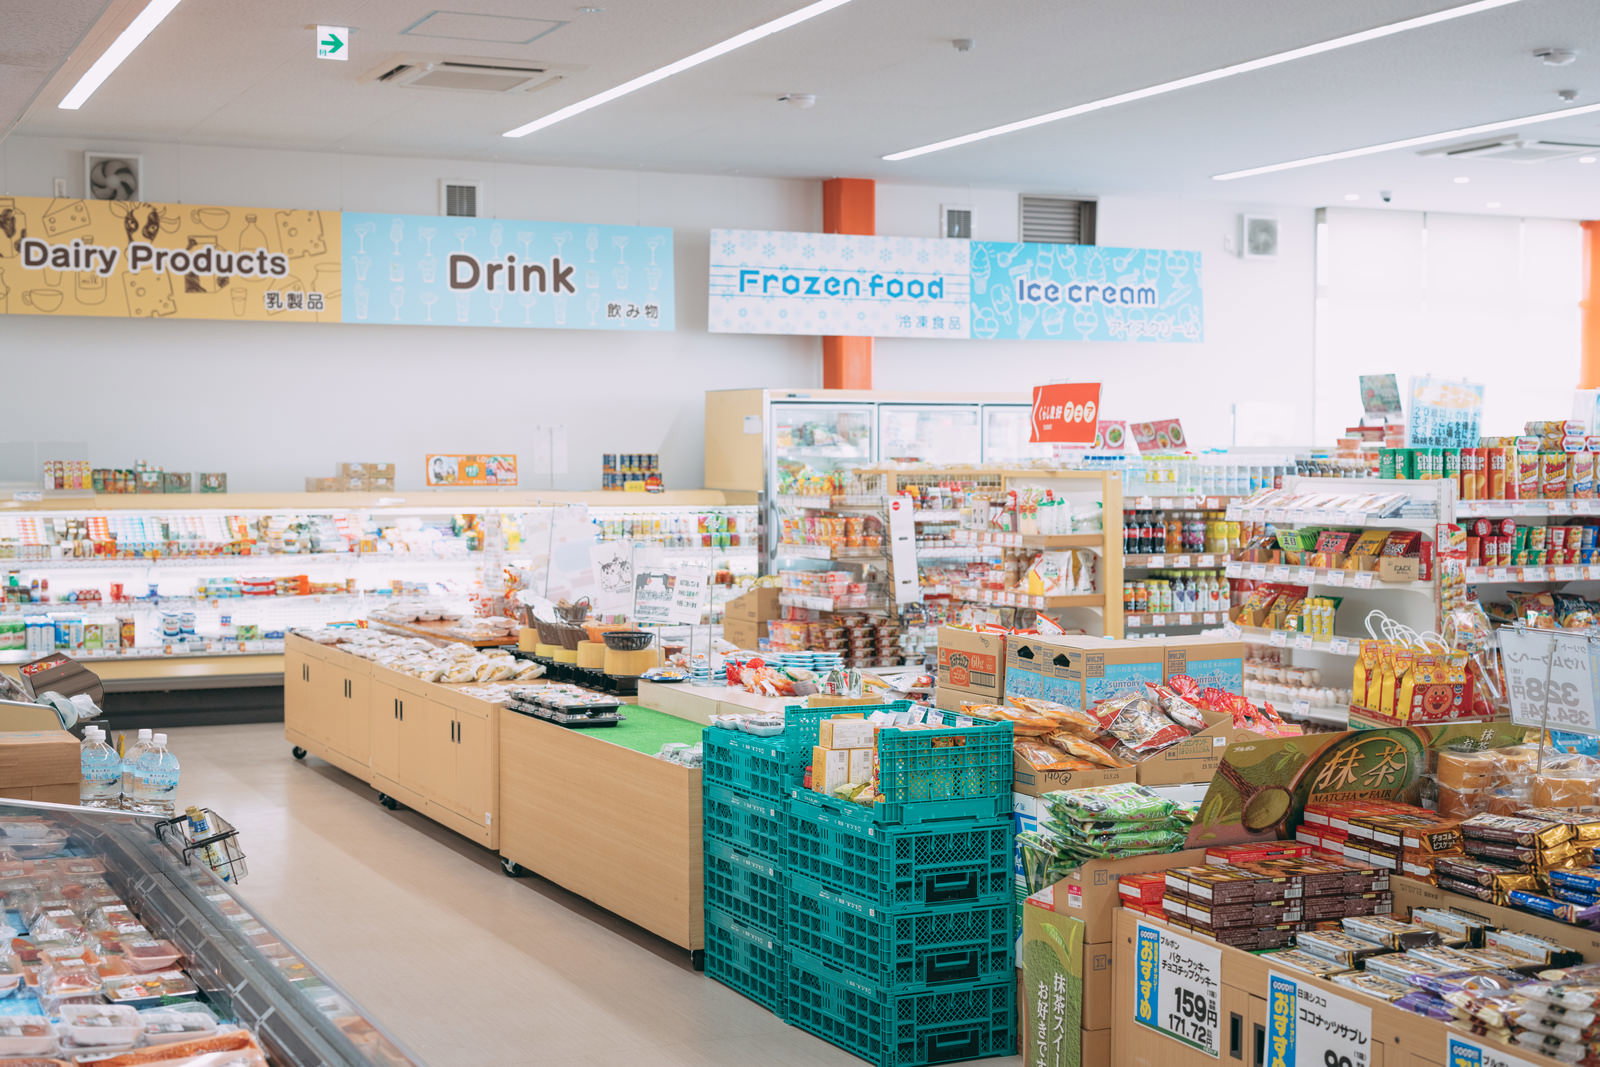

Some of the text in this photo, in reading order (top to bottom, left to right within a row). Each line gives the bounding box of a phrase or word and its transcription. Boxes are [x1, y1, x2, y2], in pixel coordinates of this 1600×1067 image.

[24, 241, 287, 275] Dairy Products
[450, 254, 575, 293] Drink
[739, 269, 944, 300] Frozen food
[266, 293, 324, 310] 乳製品
[1018, 279, 1157, 305] Ice cream
[607, 303, 658, 319] 飲み物
[898, 315, 961, 330] 冷凍食品
[1108, 680, 1140, 689] SUNTORY
[1317, 744, 1407, 790] 抹茶
[1312, 789, 1393, 803] MATCHA FAIR
[1161, 936, 1180, 950] ブルボン
[1161, 959, 1218, 988] チョコチップクッキー
[1169, 952, 1210, 974] バタークッキー
[1140, 940, 1153, 1020] おすすめ
[1175, 987, 1207, 1023] 159
[1207, 1010, 1218, 1028] 円
[1297, 988, 1327, 1008] 日清シスコ
[1169, 1013, 1206, 1043] 171.72
[1299, 1007, 1368, 1045] ココナッツサブレ
